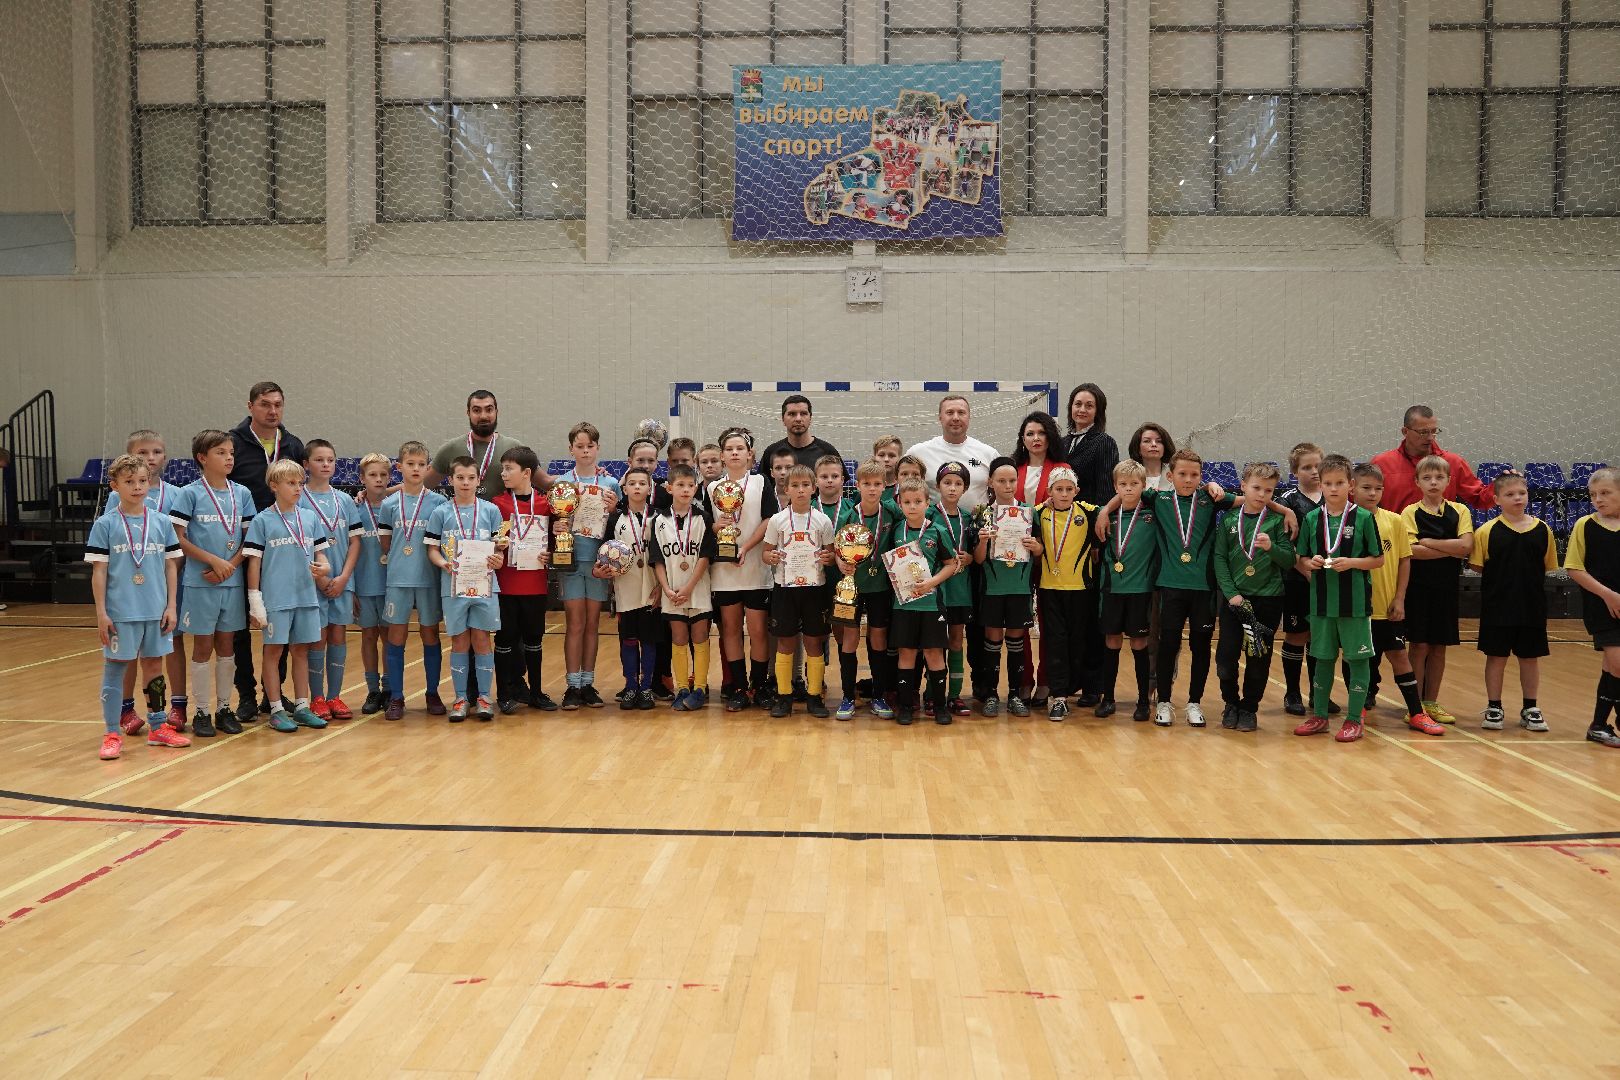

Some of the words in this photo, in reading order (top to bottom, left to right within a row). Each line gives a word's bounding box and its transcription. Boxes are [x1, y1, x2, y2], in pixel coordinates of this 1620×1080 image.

[739, 101, 870, 129] выбираем
[763, 131, 843, 160] спорт!
[182, 611, 191, 628] 4
[267, 622, 274, 639] 9
[110, 635, 119, 654] 6
